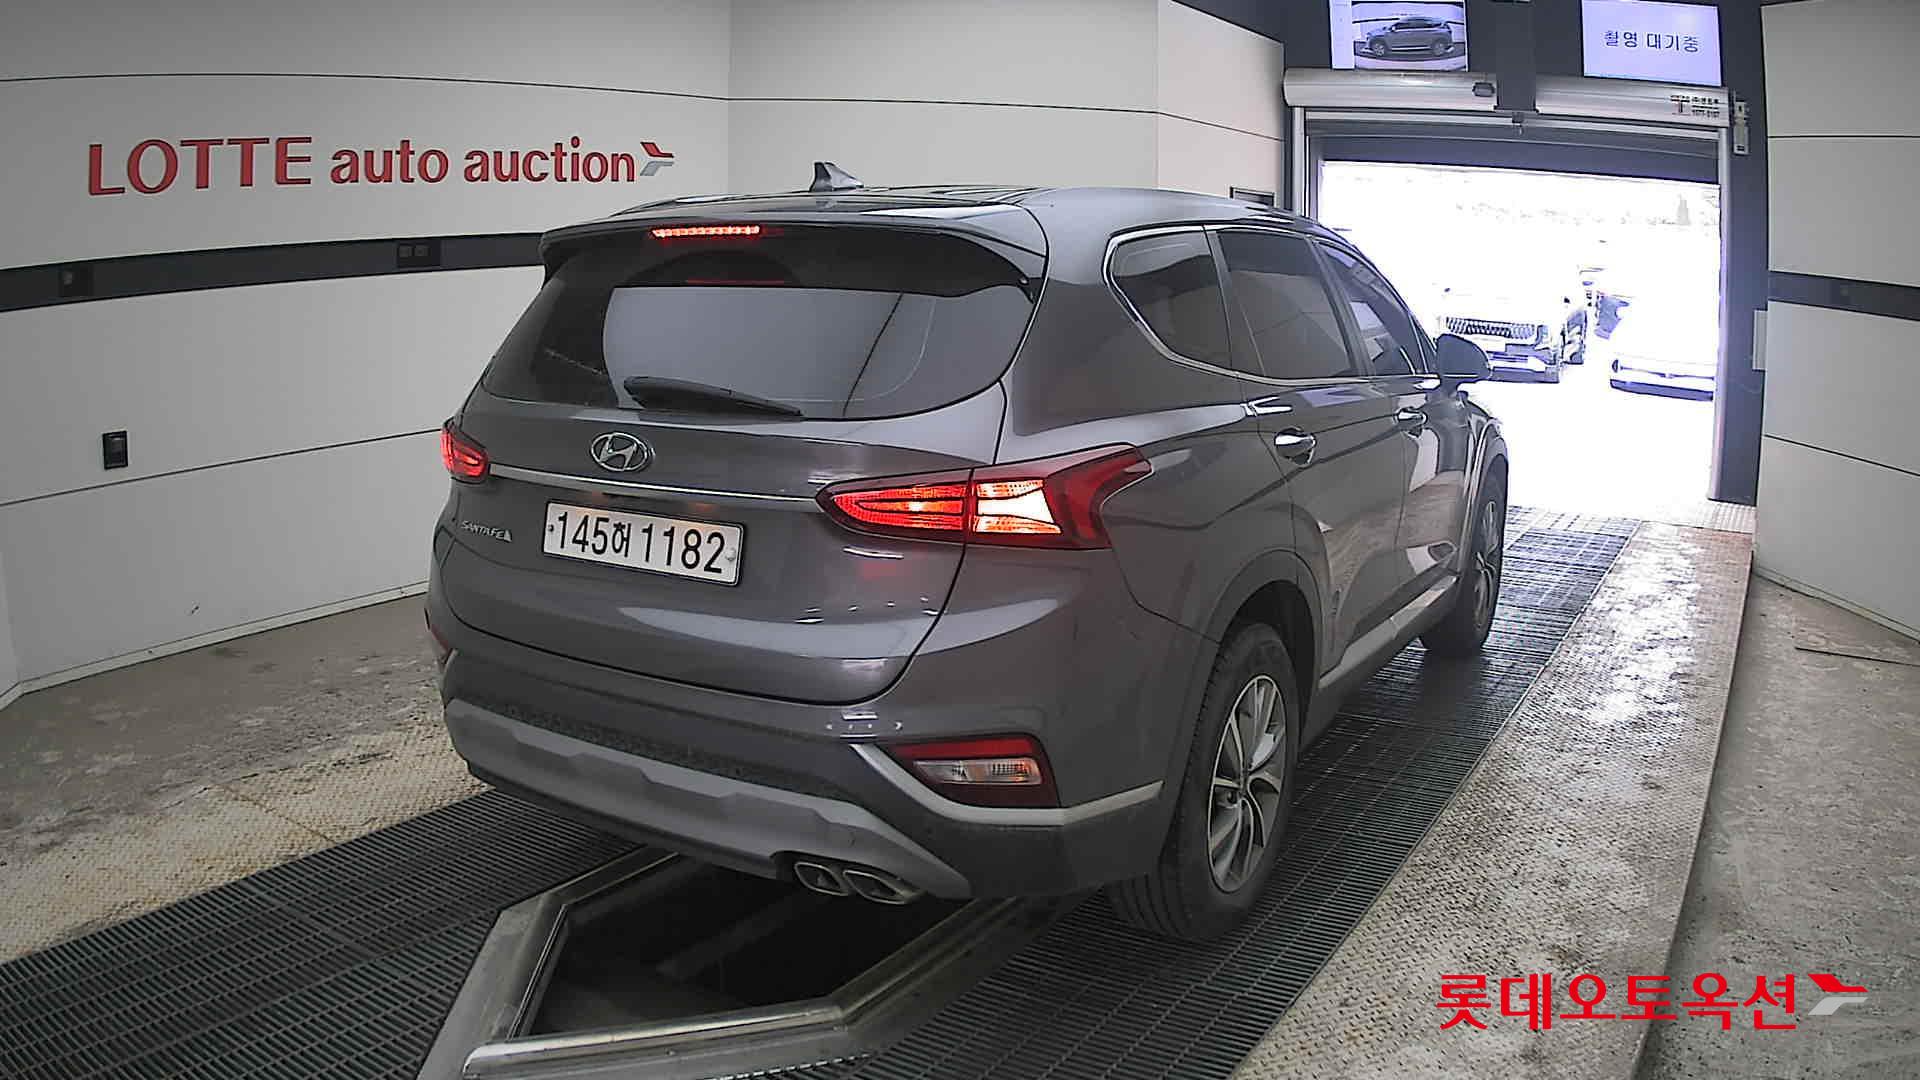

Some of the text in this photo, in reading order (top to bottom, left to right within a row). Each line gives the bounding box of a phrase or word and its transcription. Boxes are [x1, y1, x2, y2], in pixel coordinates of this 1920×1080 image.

[1604, 30, 1699, 53] 촬영 대기중
[88, 135, 637, 196] LOTTE auto auction
